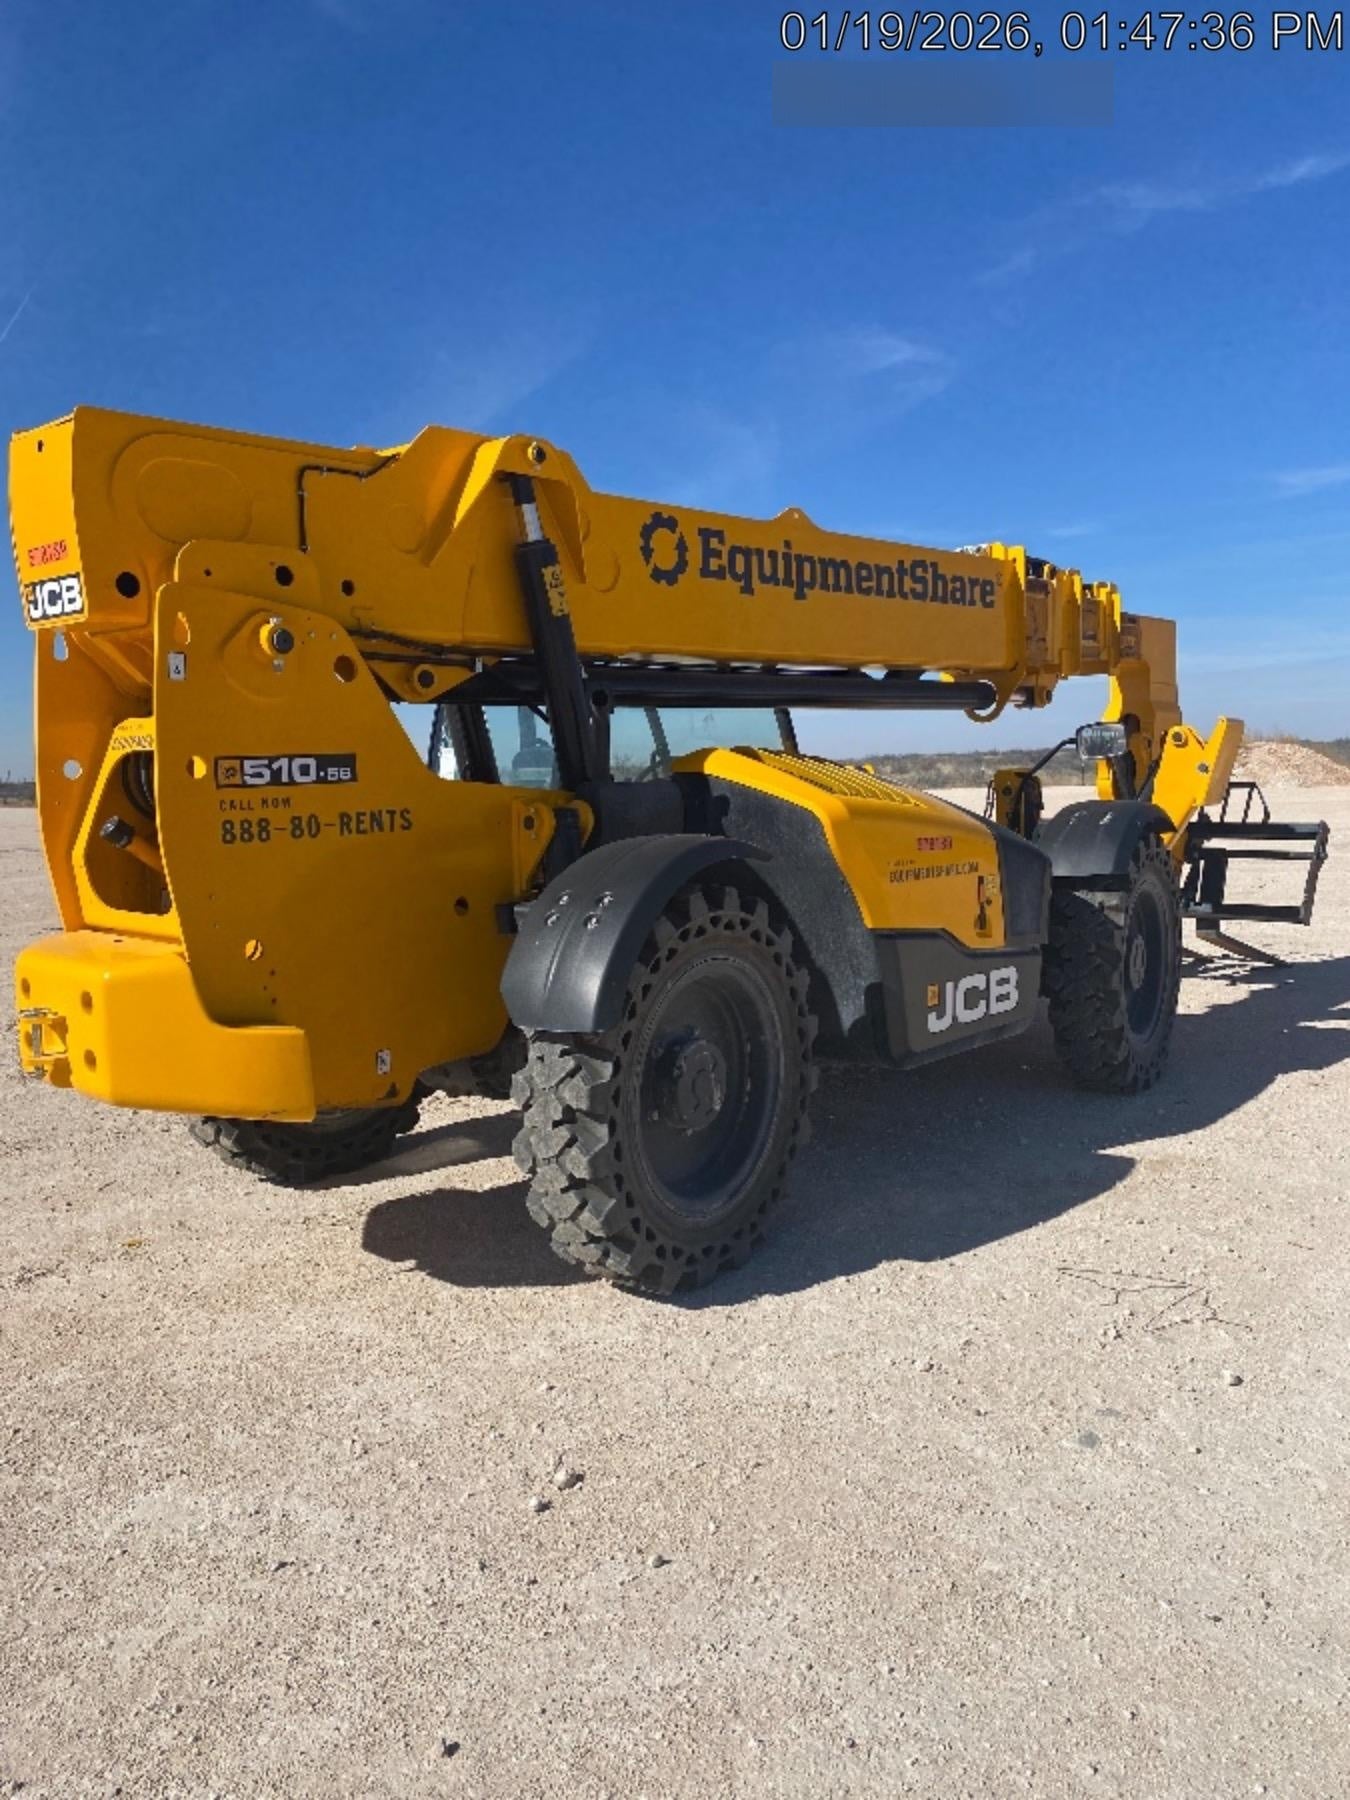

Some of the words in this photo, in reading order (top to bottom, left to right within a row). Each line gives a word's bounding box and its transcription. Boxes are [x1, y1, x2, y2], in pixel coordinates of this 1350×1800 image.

[697, 527, 996, 609] EquipmentShare
[29, 577, 83, 620] JCB
[219, 799, 255, 812] CALL
[261, 797, 292, 809] NOW
[221, 808, 414, 845] 888-80-RENTS
[927, 965, 1020, 1034] JCB
